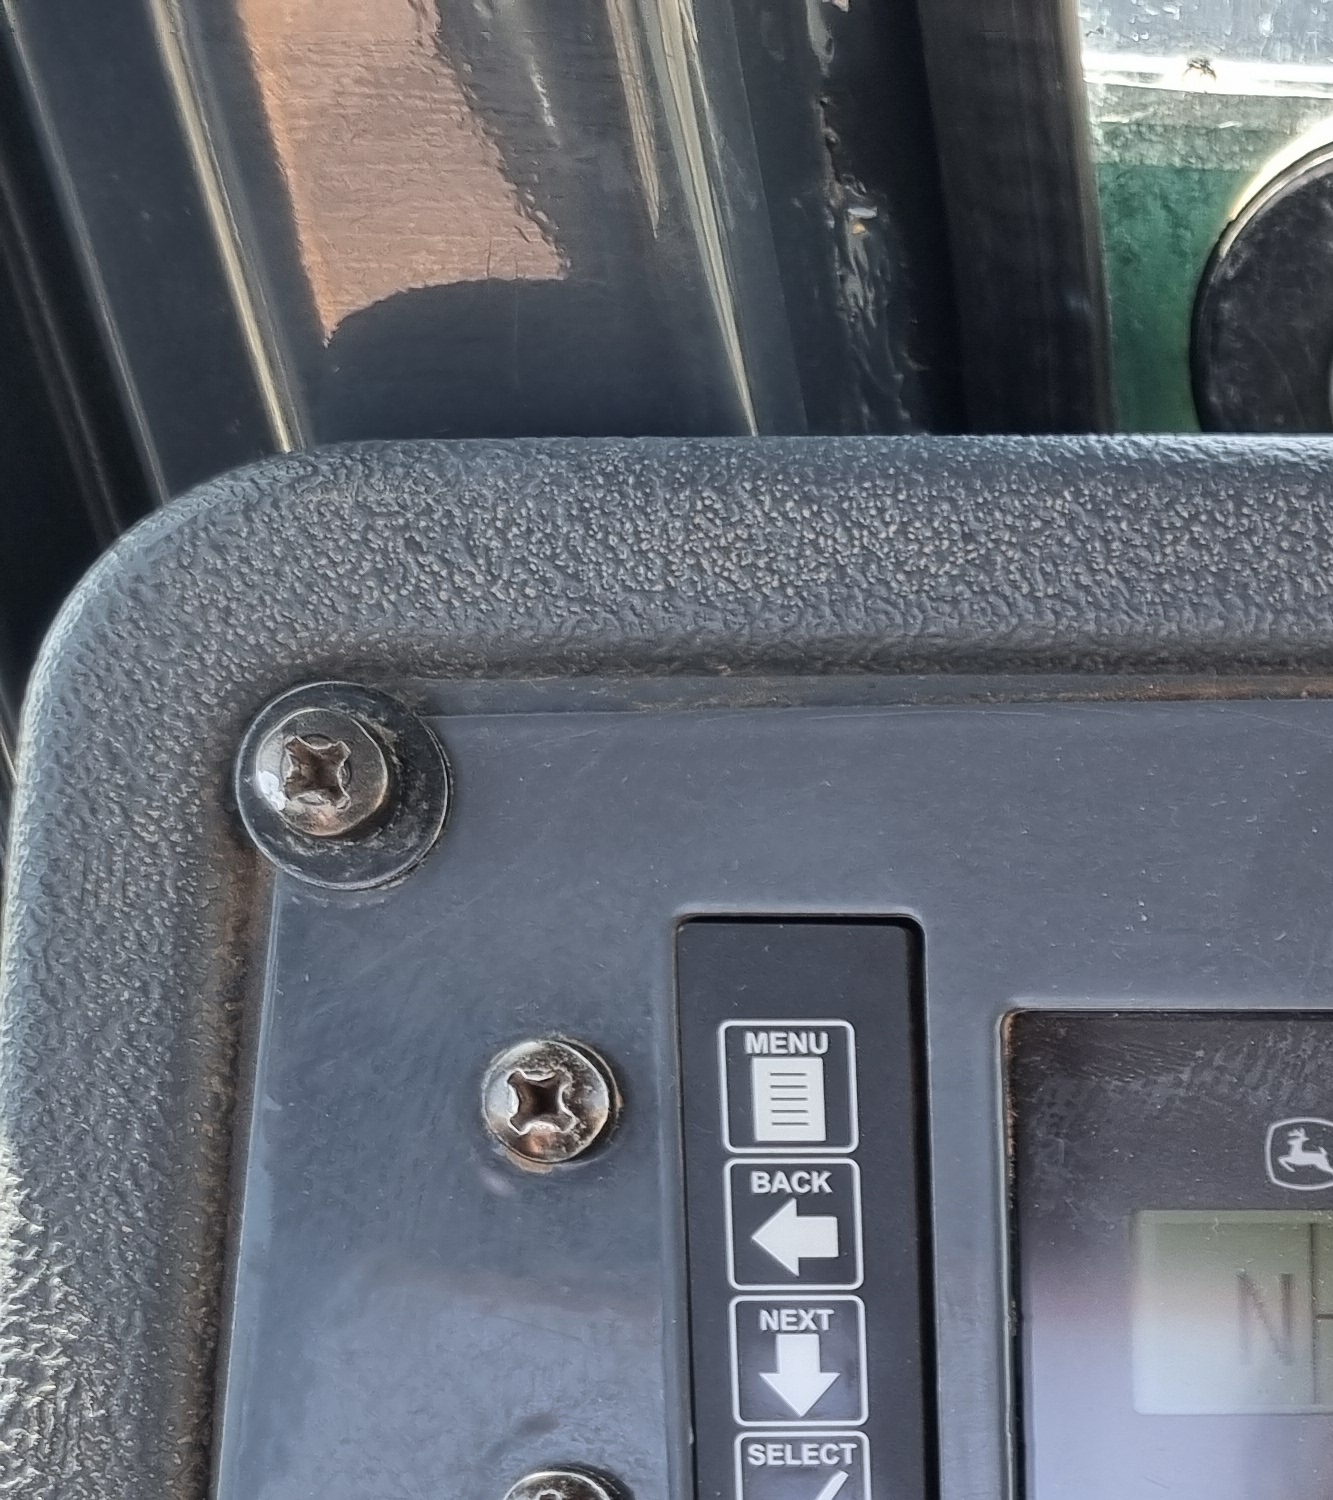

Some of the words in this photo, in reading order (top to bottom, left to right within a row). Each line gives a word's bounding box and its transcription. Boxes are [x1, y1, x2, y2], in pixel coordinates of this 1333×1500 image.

[744, 1030, 829, 1055] MENU
[751, 1170, 833, 1195] BACK
[759, 1309, 834, 1331] NEXT
[1236, 1269, 1296, 1366] N
[747, 1442, 858, 1466] SELECT
